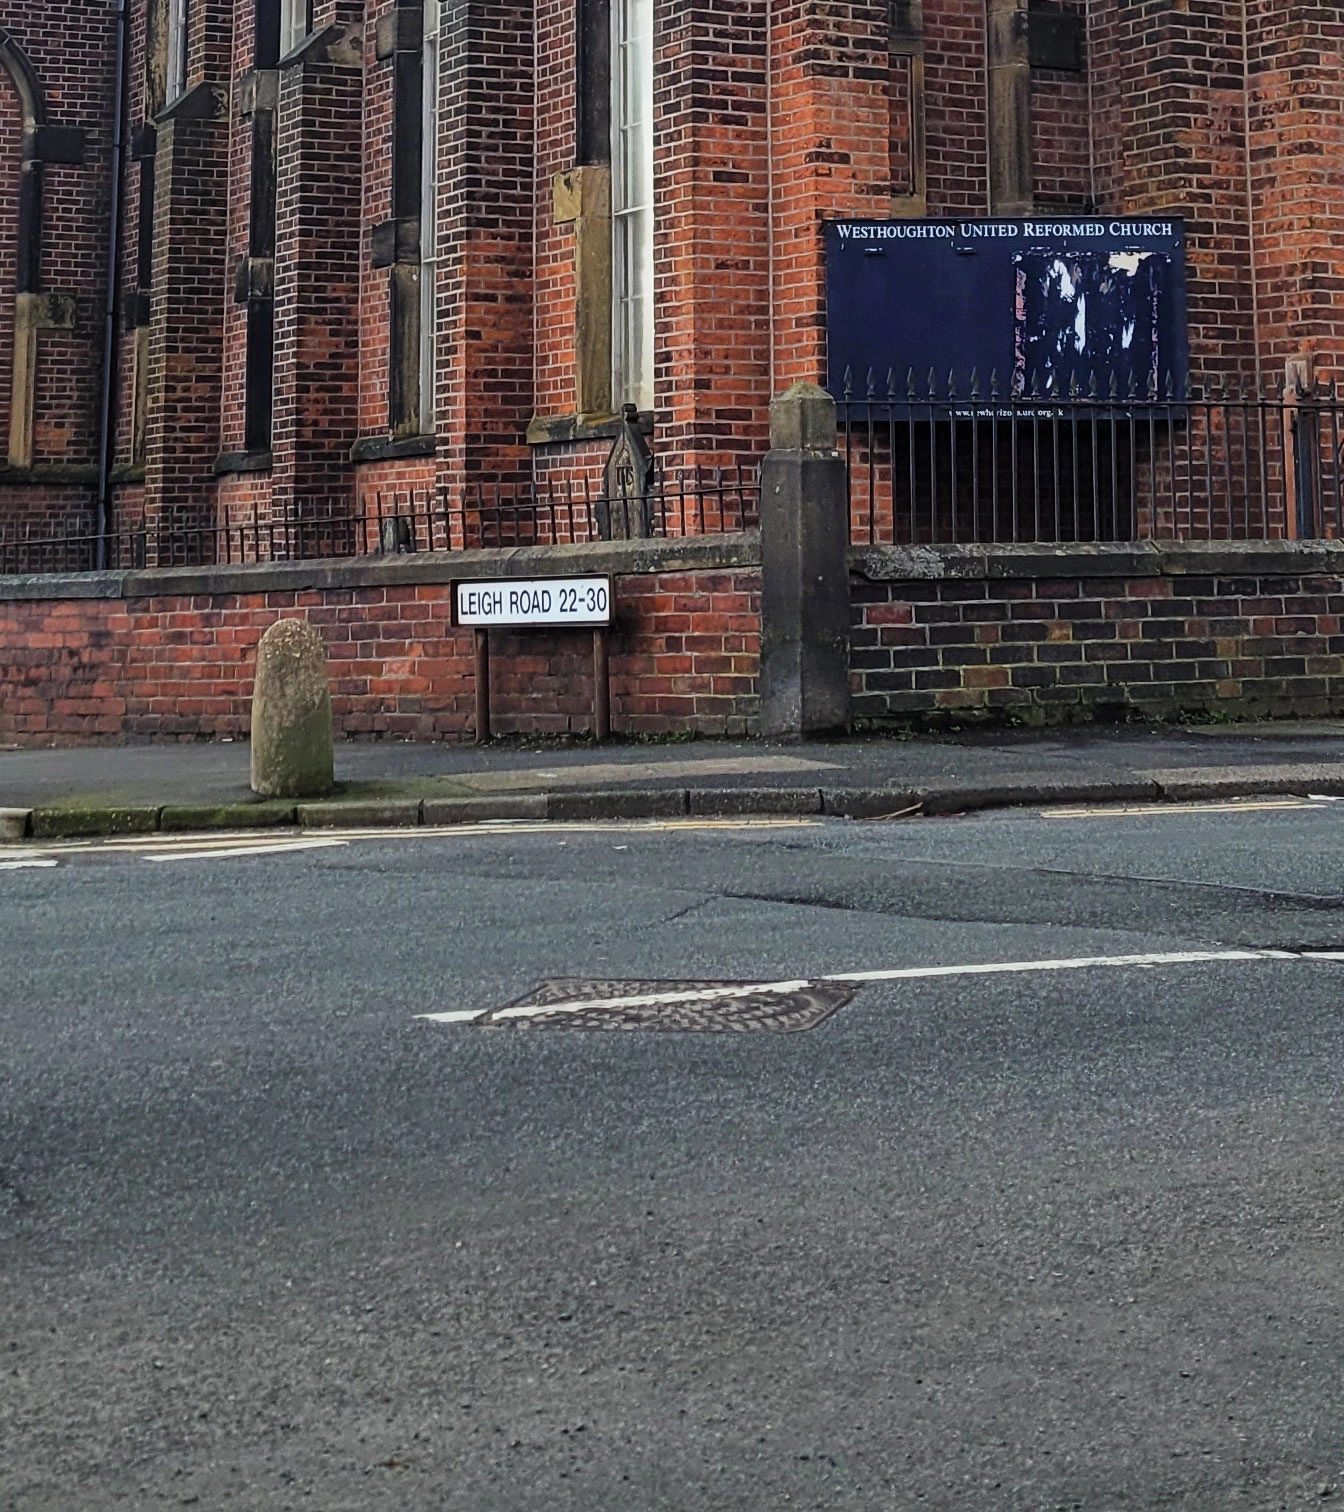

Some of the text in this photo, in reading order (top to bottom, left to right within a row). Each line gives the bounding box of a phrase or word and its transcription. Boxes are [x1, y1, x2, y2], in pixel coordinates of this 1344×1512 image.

[836, 221, 1173, 239] WESTHOUGHTON UNITED REFORMED CHURCH
[460, 587, 607, 616] LEIGH ROAD 22-30
